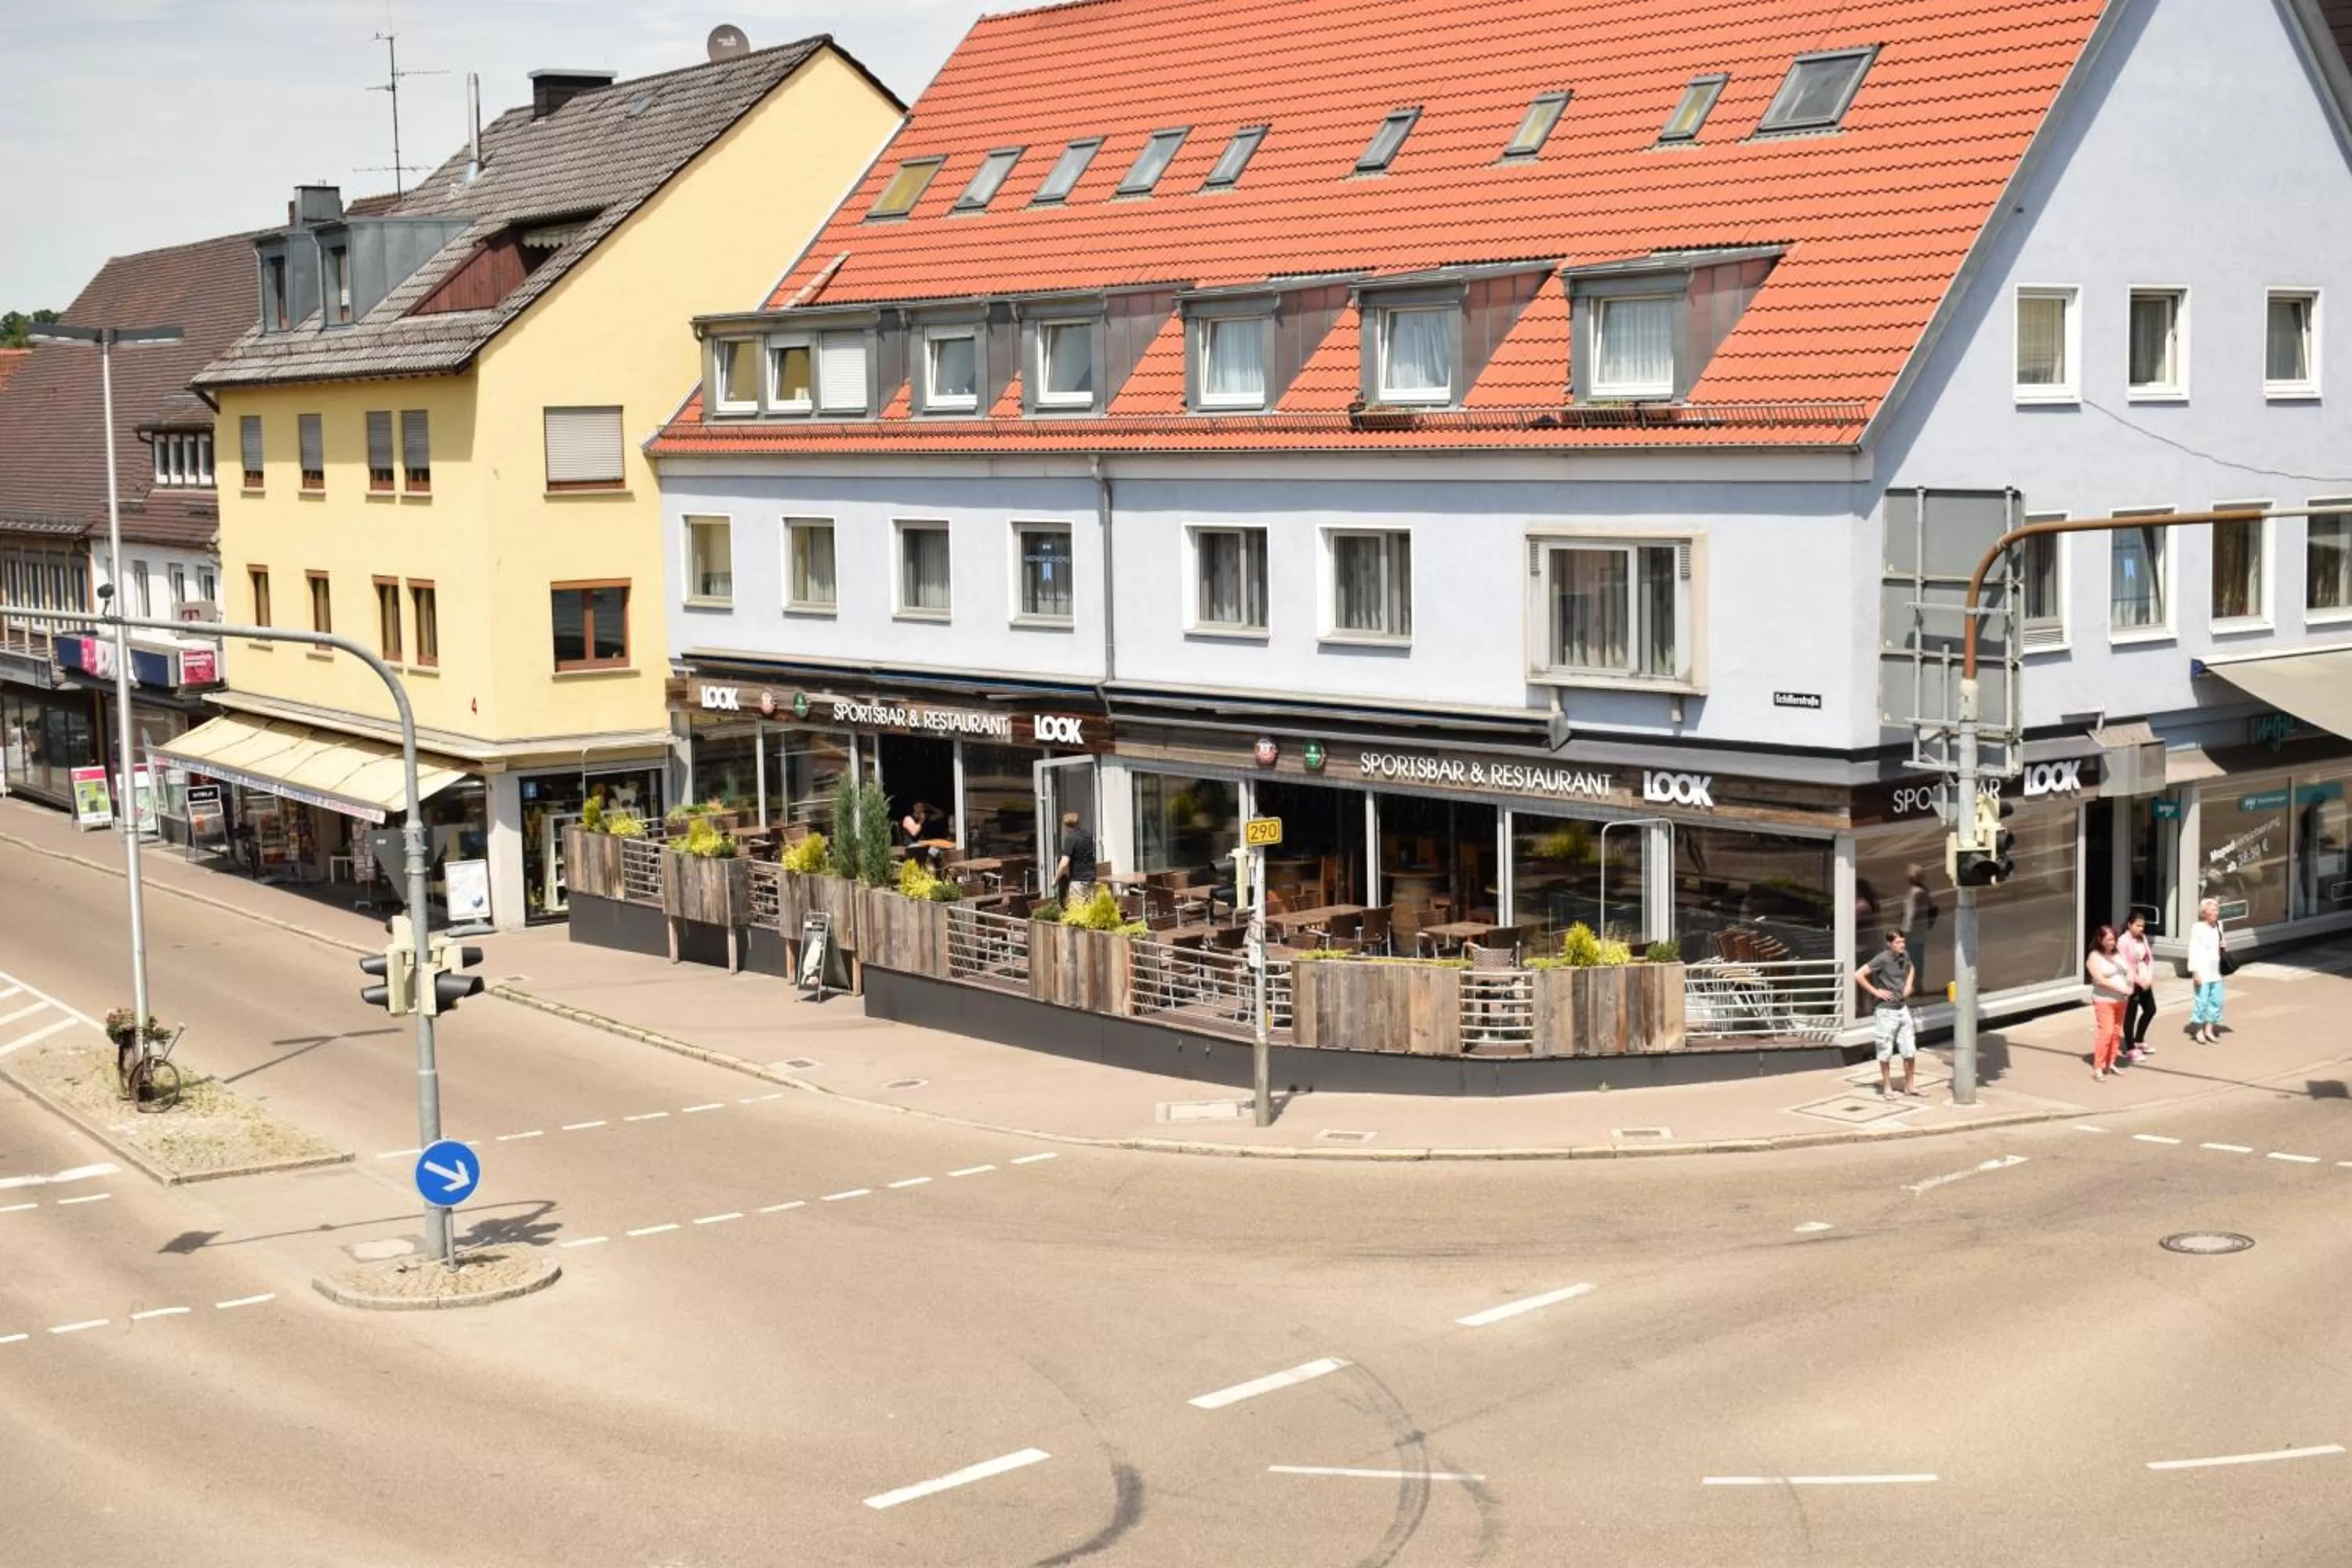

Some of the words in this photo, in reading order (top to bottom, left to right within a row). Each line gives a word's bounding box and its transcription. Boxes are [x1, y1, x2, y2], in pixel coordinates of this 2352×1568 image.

[701, 685, 740, 712] LOOK
[833, 702, 906, 728] SPORTSBAR
[909, 711, 920, 728] &
[924, 713, 1008, 735] RESTAURANT
[1034, 714, 1083, 744] LOOK
[1361, 752, 1465, 784] SPORTSBAR
[1471, 763, 1486, 782] &
[1490, 764, 1612, 797] RESTAURANT
[1644, 770, 1713, 808] LOOK
[1893, 779, 2001, 814] SPOAR
[2024, 759, 2082, 797] LOOK
[1250, 823, 1277, 840] 290
